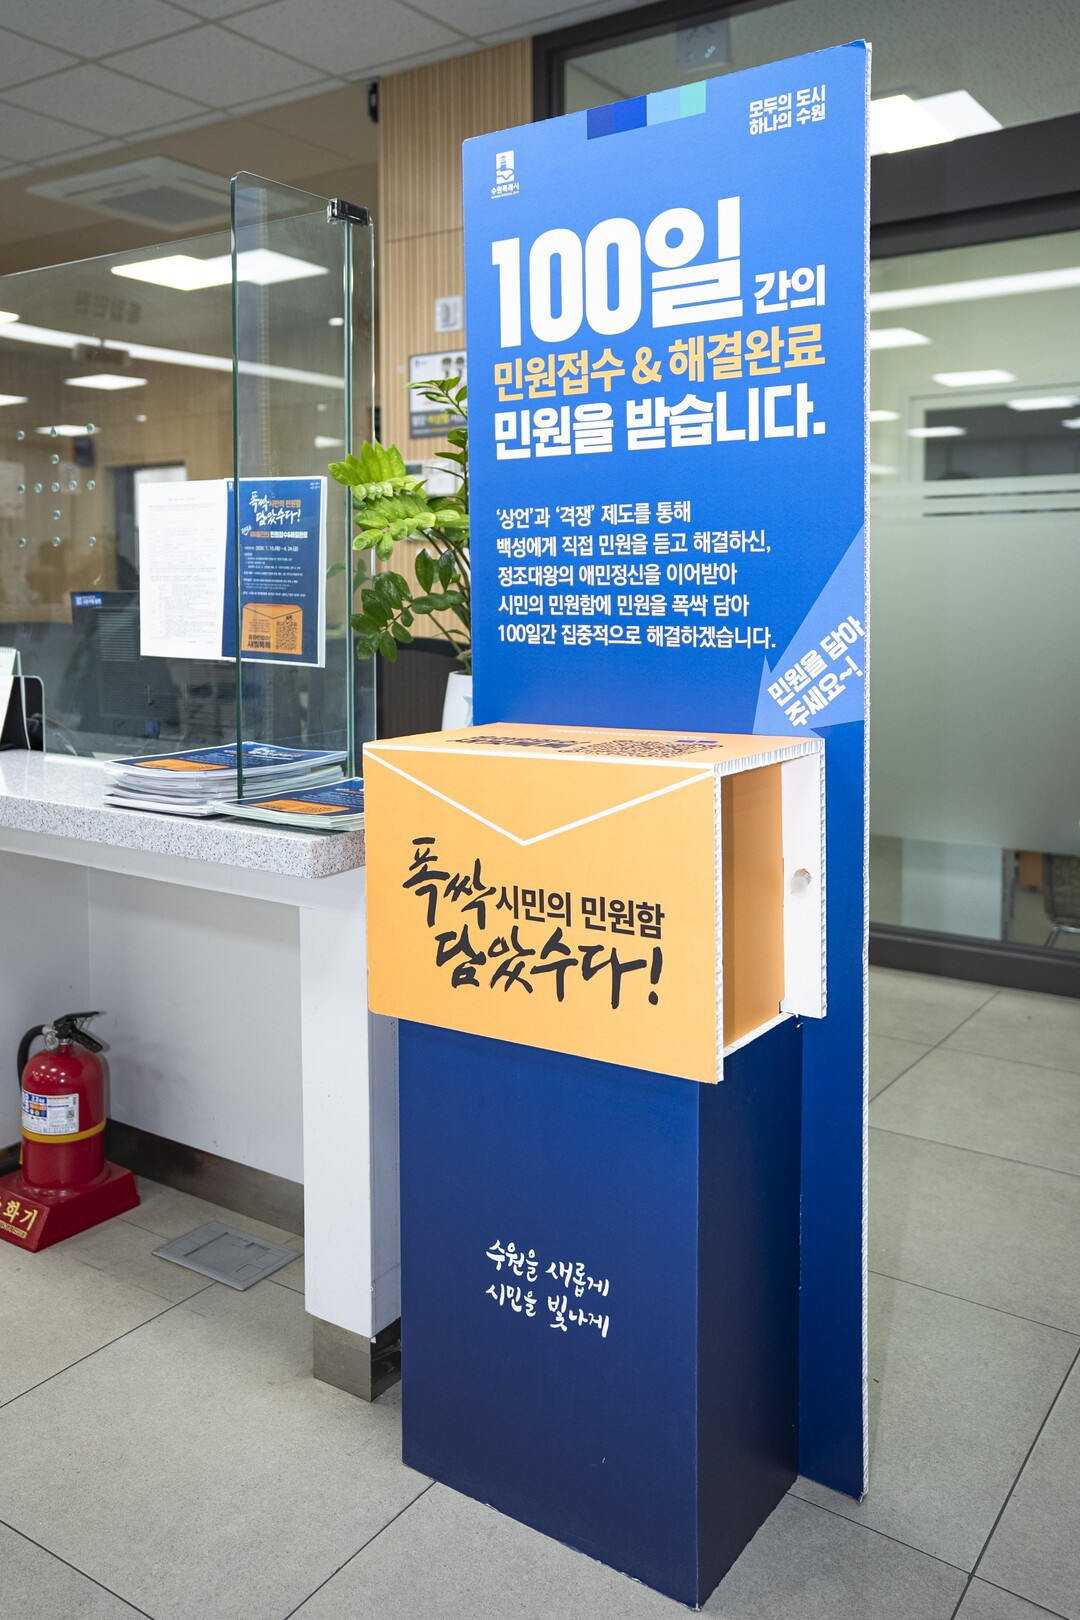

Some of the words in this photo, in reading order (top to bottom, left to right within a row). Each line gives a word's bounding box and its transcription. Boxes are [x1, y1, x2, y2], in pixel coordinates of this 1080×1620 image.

[749, 92, 792, 118] 모두의
[796, 84, 826, 107] 도시
[749, 111, 792, 136] 하나의
[796, 103, 826, 125] 수원
[490, 182, 520, 196] 수원특례시
[492, 196, 743, 348] 100일
[754, 264, 826, 314] 간의
[494, 348, 626, 402] 민원접수
[632, 346, 662, 384] &
[668, 323, 826, 382] 해결완료
[494, 402, 614, 460] 민원을
[626, 383, 826, 451] 받습니다.
[601, 503, 651, 525] 제도를
[656, 501, 690, 523] 통해
[497, 536, 556, 558] 백성에게
[562, 535, 593, 556] 직접
[599, 534, 648, 555] 민원을
[653, 533, 688, 554] 듣고
[694, 530, 770, 553] 해결하신,
[498, 566, 573, 587] 정조대왕의
[579, 564, 661, 586] 애민정신을
[667, 563, 737, 585] 이어받아
[498, 595, 543, 615] 시민의
[549, 595, 611, 615] 민원함에
[618, 595, 667, 616] 민원을
[672, 595, 708, 616] 폭싹
[714, 595, 749, 616] 담아
[498, 624, 557, 644] 100일간
[561, 624, 641, 645] 집중적으로
[647, 626, 775, 649] 해결하겠습니다.
[767, 650, 828, 707] 민원을
[820, 616, 865, 660] 담아
[402, 836, 497, 930] 폭싹
[495, 885, 571, 927] 시민의
[581, 896, 665, 939] 민원함
[434, 925, 662, 1010] 담았수다!
[0, 1195, 38, 1232] 화기
[486, 1240, 538, 1282] 수원을
[545, 1261, 610, 1297] 새롭게
[485, 1283, 537, 1317] 시민을
[547, 1295, 610, 1338] 빛나게
